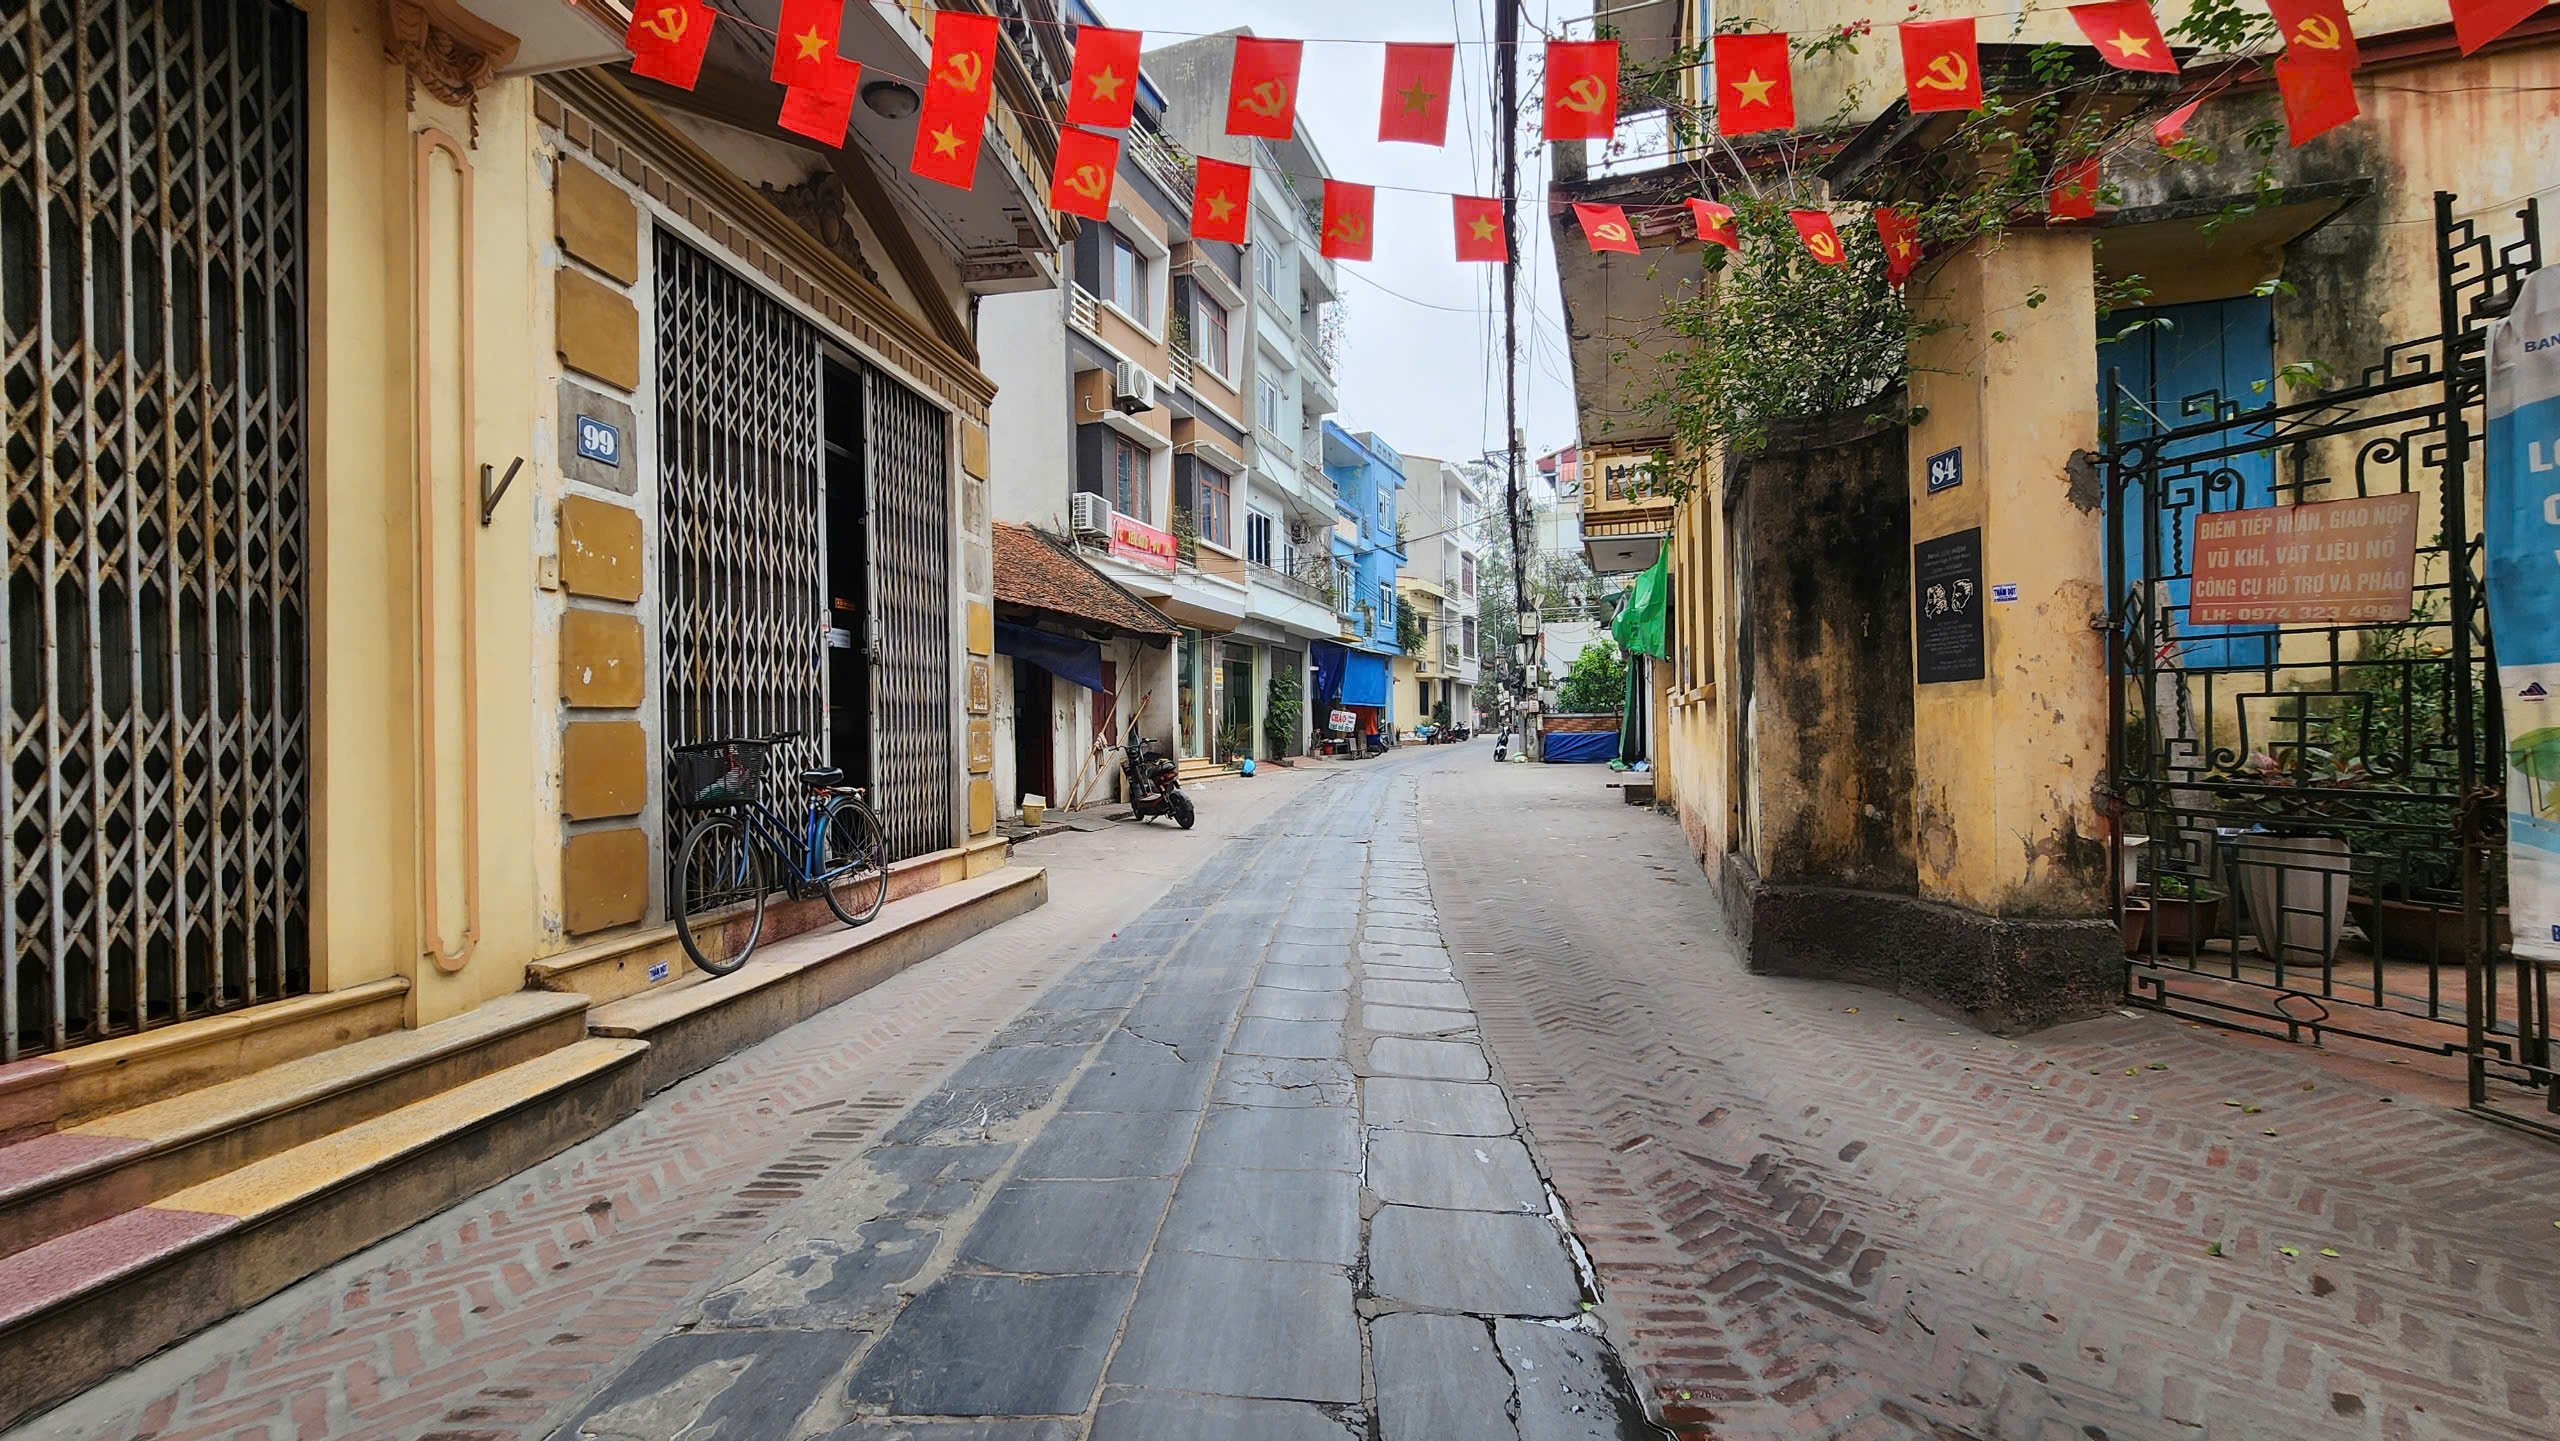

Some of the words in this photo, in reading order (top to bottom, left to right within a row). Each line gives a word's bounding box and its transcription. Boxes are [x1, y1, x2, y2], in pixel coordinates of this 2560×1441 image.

[583, 424, 615, 456] 99
[1931, 455, 1957, 485] 84
[2200, 514, 2236, 540] ĐIỂM
[2240, 512, 2273, 537] TIẾP
[2276, 510, 2325, 536] NHẬN,
[2329, 508, 2368, 529] GIAO
[2373, 501, 2411, 529] NỘP
[2207, 547, 2230, 569] VŨ
[2234, 544, 2270, 568] KHÍ,
[2275, 543, 2311, 568] VẬT
[2315, 539, 2360, 565] LIỆU
[2196, 576, 2237, 598] CÔNG
[2240, 577, 2262, 600] CỤ
[2266, 570, 2289, 595] HỖ
[2292, 572, 2325, 598] TRỢ
[2329, 569, 2352, 593] VÀ
[2357, 567, 2407, 592] PHÁO
[2201, 608, 2233, 622] LH:
[2238, 606, 2290, 621] 0974
[2297, 605, 2341, 619] 323
